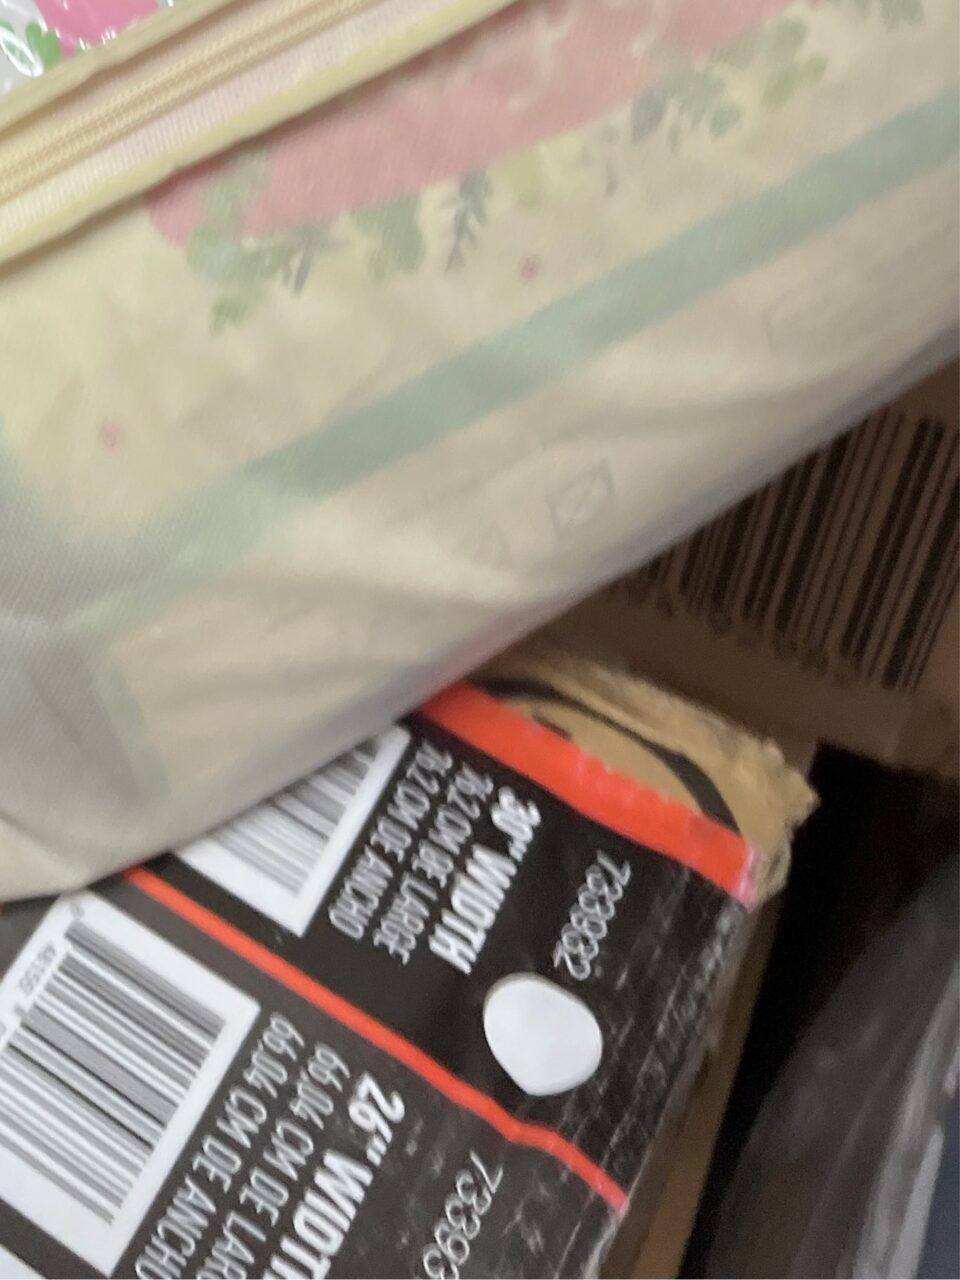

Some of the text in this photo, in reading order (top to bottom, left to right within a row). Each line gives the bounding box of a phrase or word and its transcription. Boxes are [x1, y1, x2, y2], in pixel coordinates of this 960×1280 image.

[388, 779, 430, 830] CM
[429, 803, 472, 855] CM
[370, 816, 412, 863] DE
[412, 838, 454, 888] DE
[328, 844, 393, 940] ANCHO
[373, 872, 438, 966] LARGE
[429, 843, 517, 975] WIDTH
[217, 1087, 267, 1148] CM
[192, 1136, 241, 1192] DE
[264, 1120, 314, 1181] CM
[240, 1167, 289, 1226] DE
[135, 1174, 216, 1280] ANCHO
